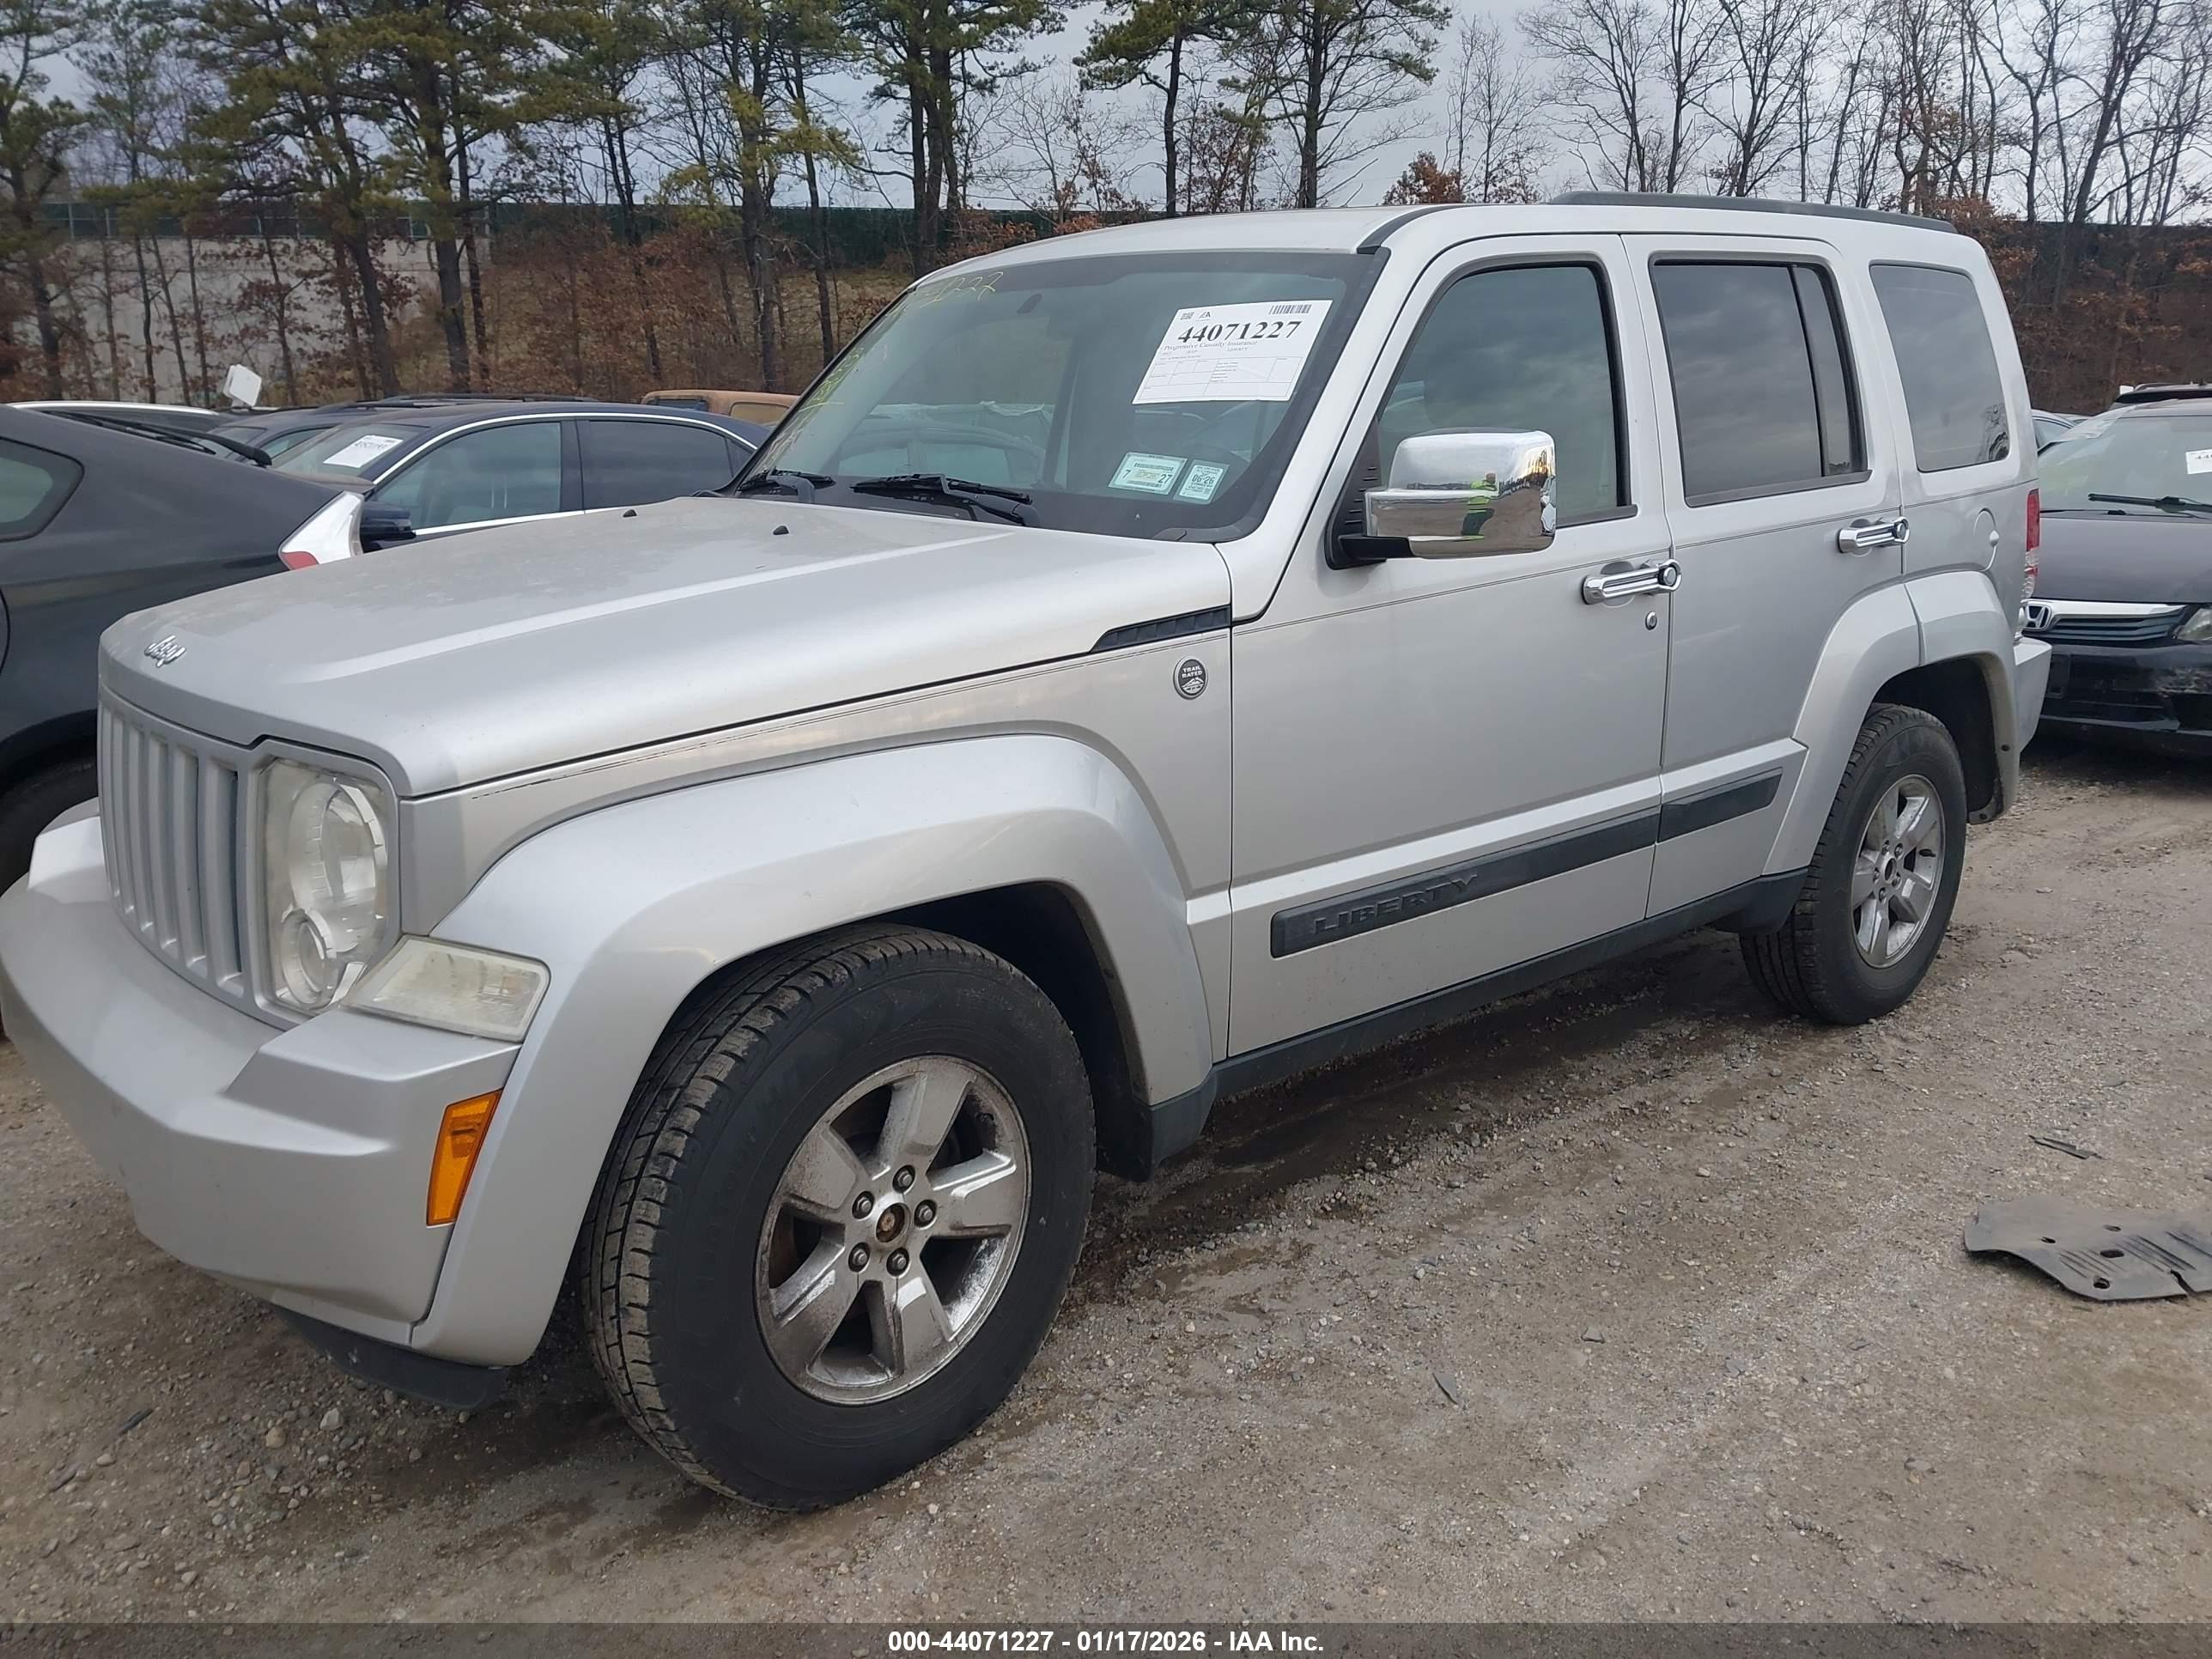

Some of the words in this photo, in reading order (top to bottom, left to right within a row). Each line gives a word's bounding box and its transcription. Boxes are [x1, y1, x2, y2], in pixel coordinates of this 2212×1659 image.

[1177, 321, 1303, 343] 44071227
[1122, 469, 1132, 479] 7
[1158, 473, 1173, 484] 27
[1182, 670, 1203, 678] RATED
[1312, 873, 1478, 935] LIBERTY
